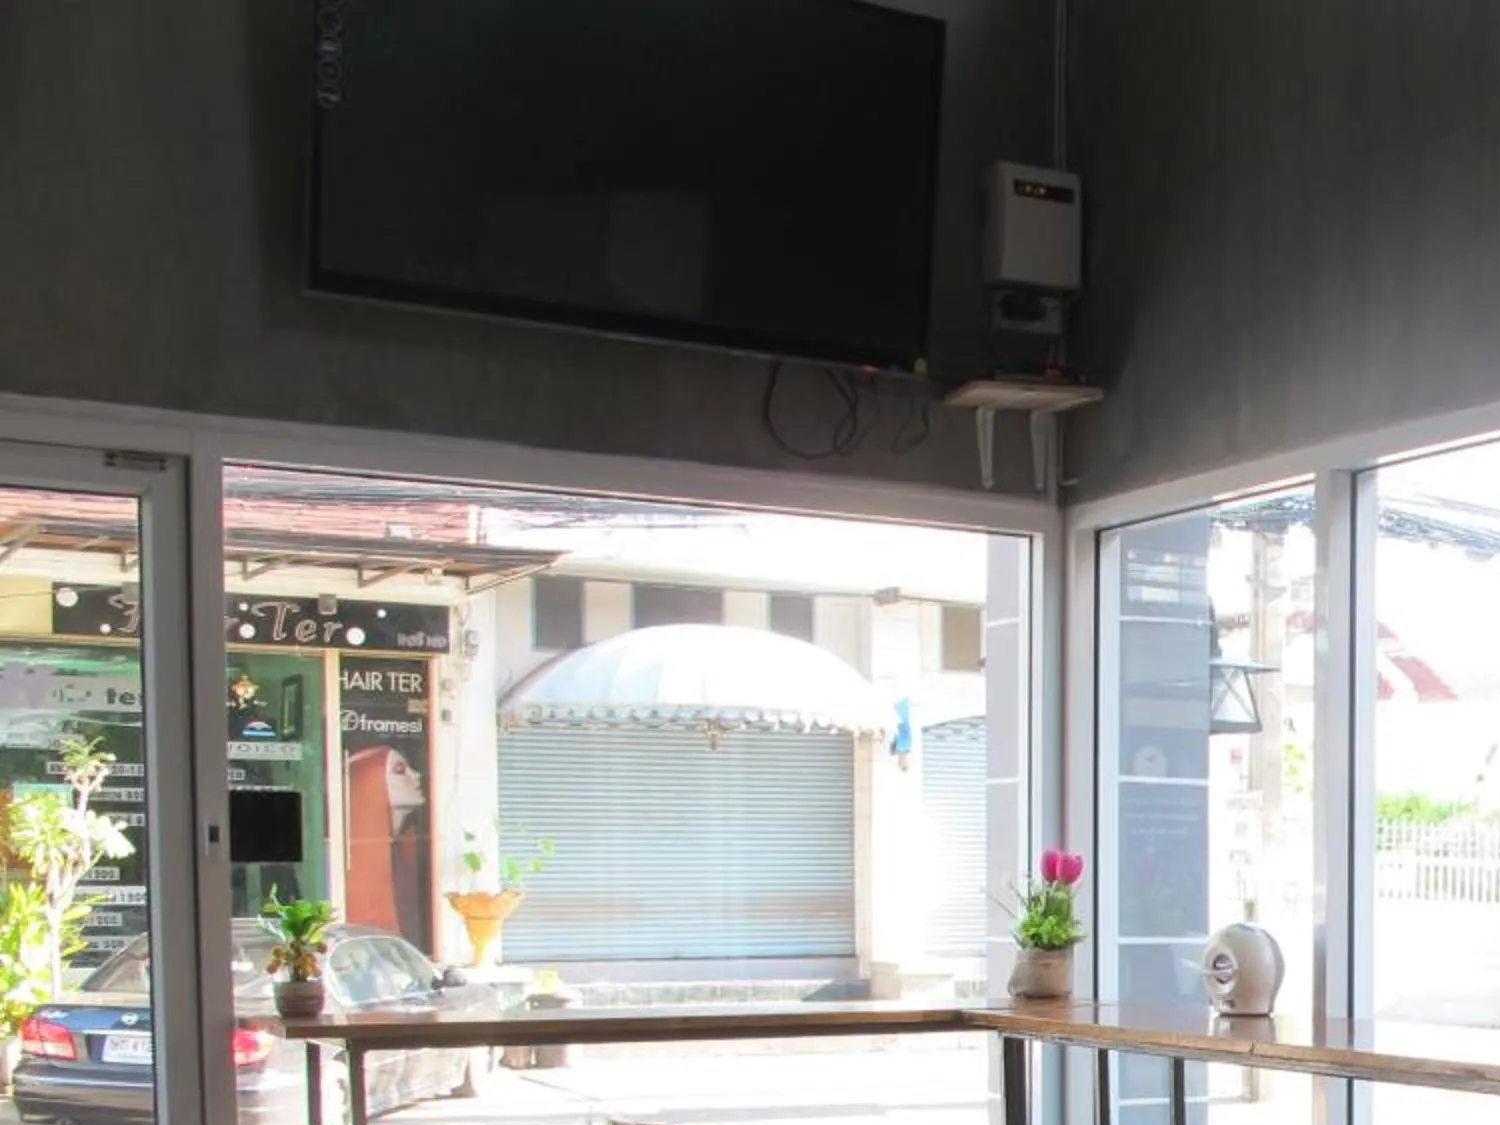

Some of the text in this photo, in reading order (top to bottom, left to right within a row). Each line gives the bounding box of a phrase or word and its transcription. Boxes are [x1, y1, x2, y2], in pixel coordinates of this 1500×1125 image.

[251, 601, 344, 643] Ter
[386, 672, 423, 692] TER
[106, 687, 143, 705] te
[361, 715, 423, 733] framesi
